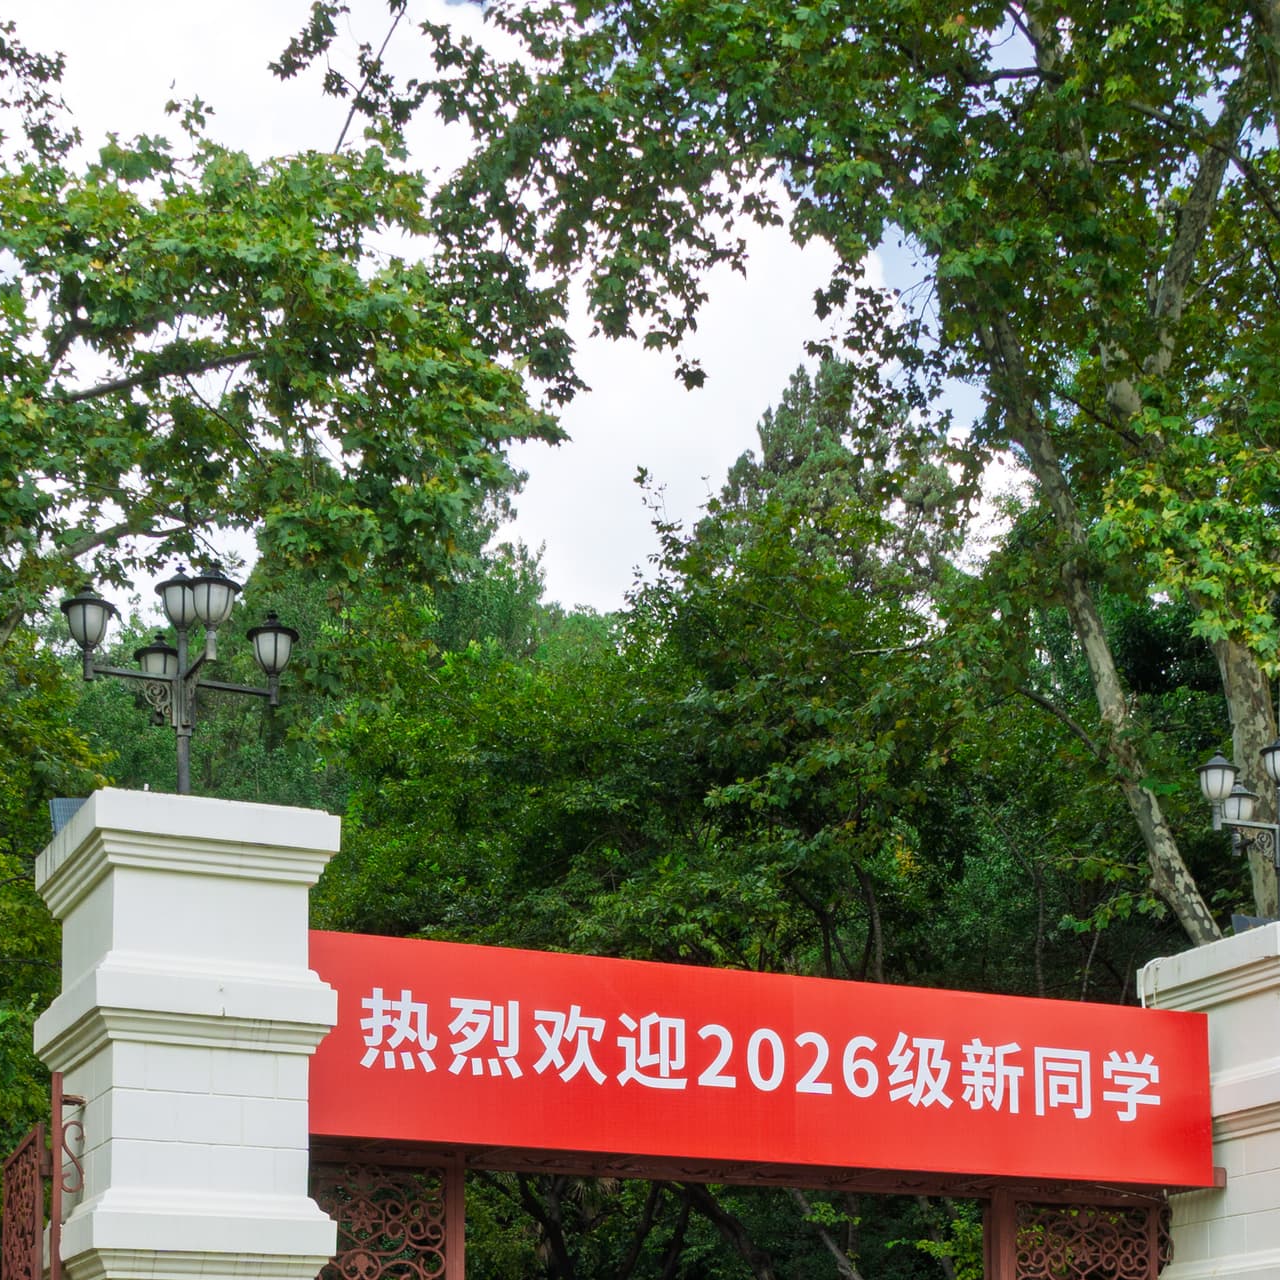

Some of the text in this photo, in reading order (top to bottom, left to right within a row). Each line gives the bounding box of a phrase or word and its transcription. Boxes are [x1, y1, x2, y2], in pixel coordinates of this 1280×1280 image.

[359, 987, 1161, 1122] 热烈欢迎2026级新同学
